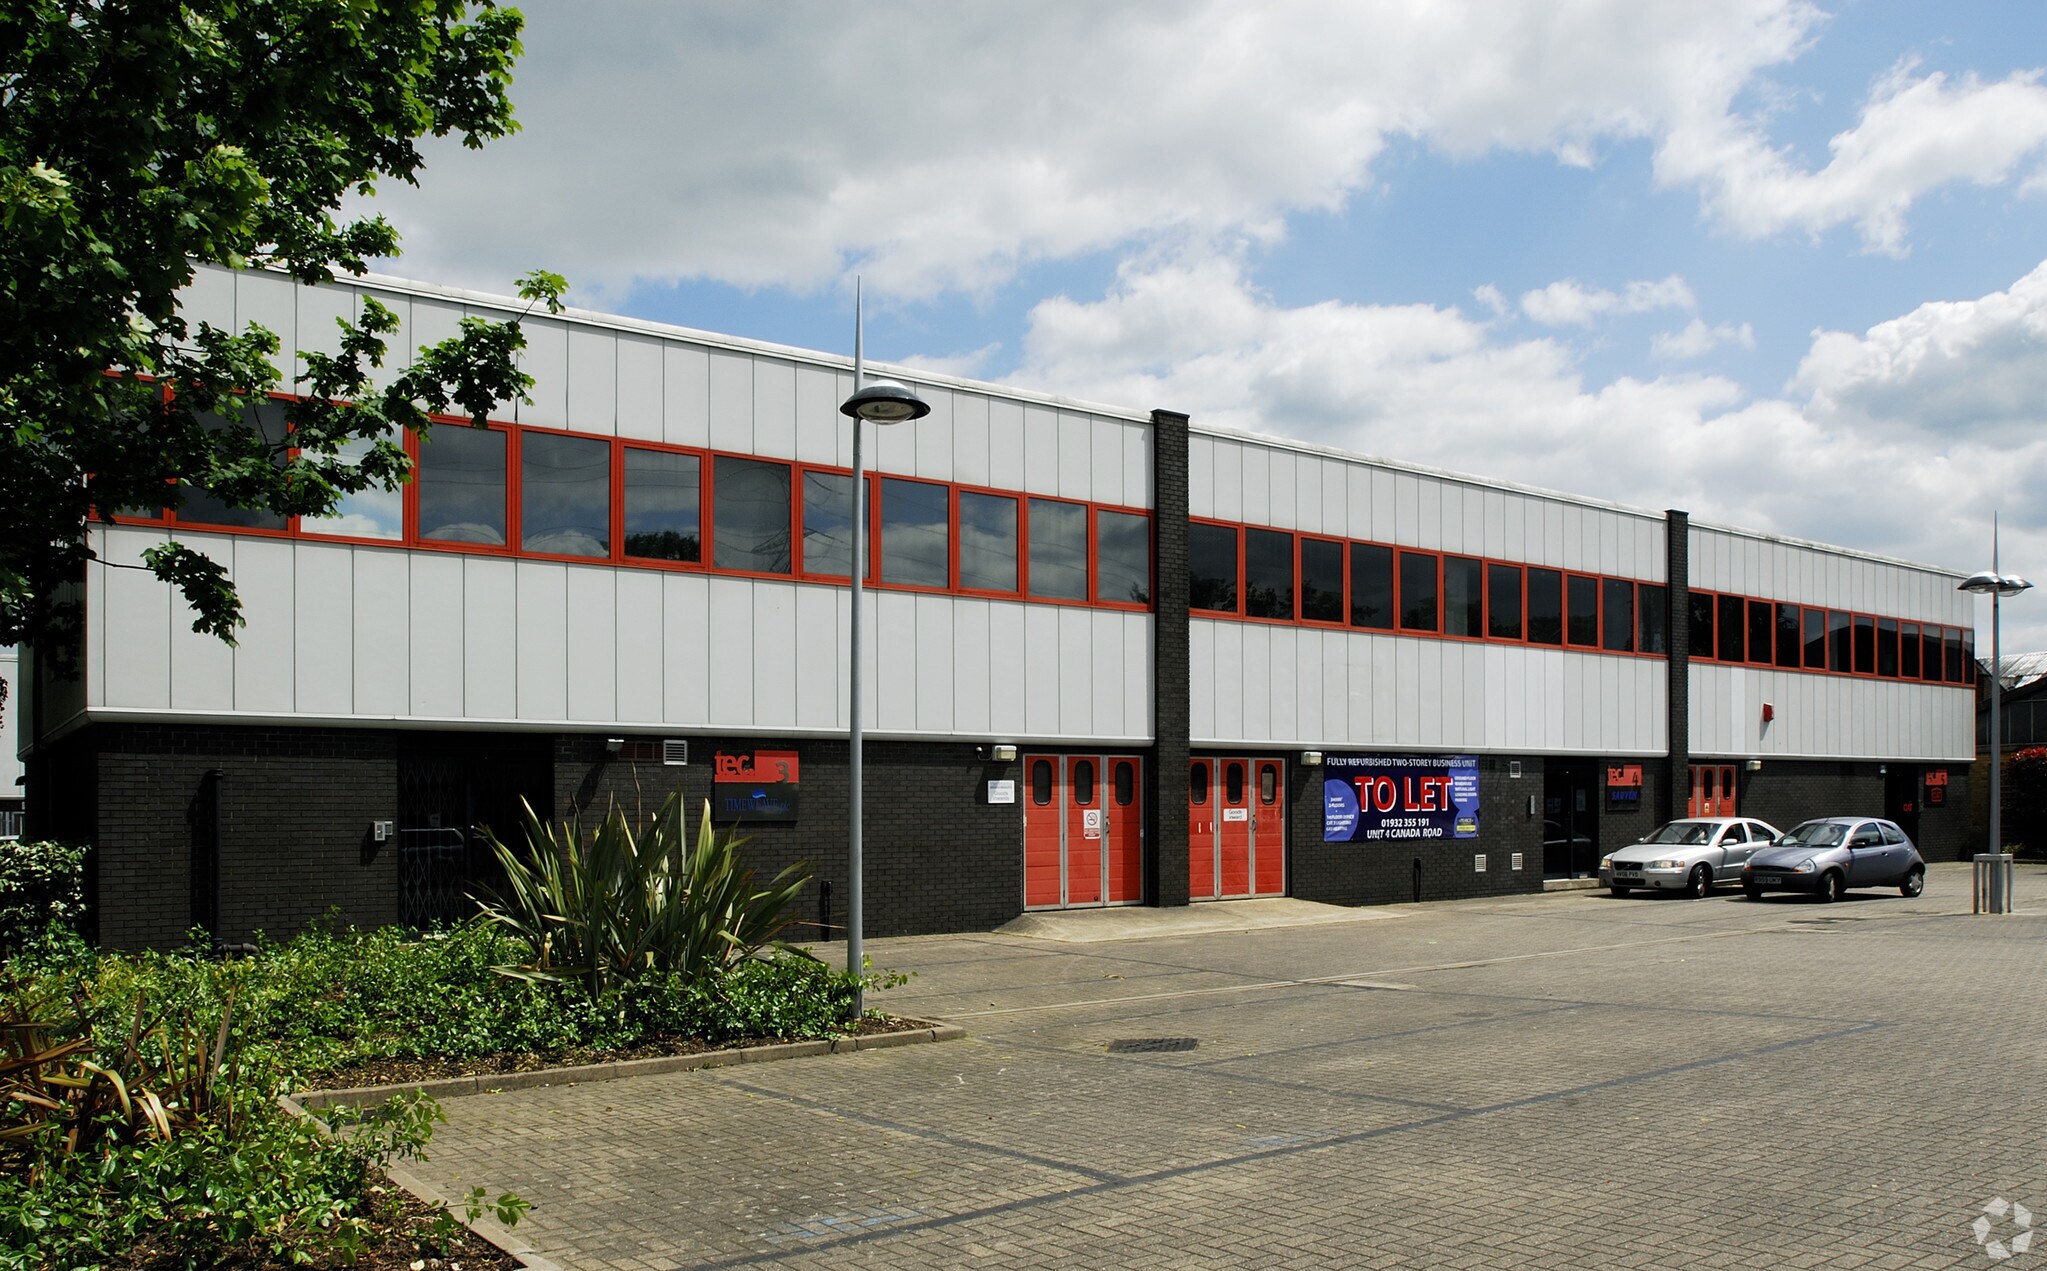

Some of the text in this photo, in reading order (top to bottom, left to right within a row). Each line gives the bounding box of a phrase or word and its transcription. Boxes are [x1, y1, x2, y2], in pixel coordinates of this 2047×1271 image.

[1327, 757, 1476, 768] FULLY REFURBISHED TWO-STOREY BUSINESS UNIT
[776, 760, 790, 783] 3
[1632, 771, 1639, 786] 4
[1354, 776, 1454, 813] TO LET
[1381, 818, 1430, 828] 01932 355 191
[1367, 828, 1443, 839] UNIT 4 CANADA ROAD
